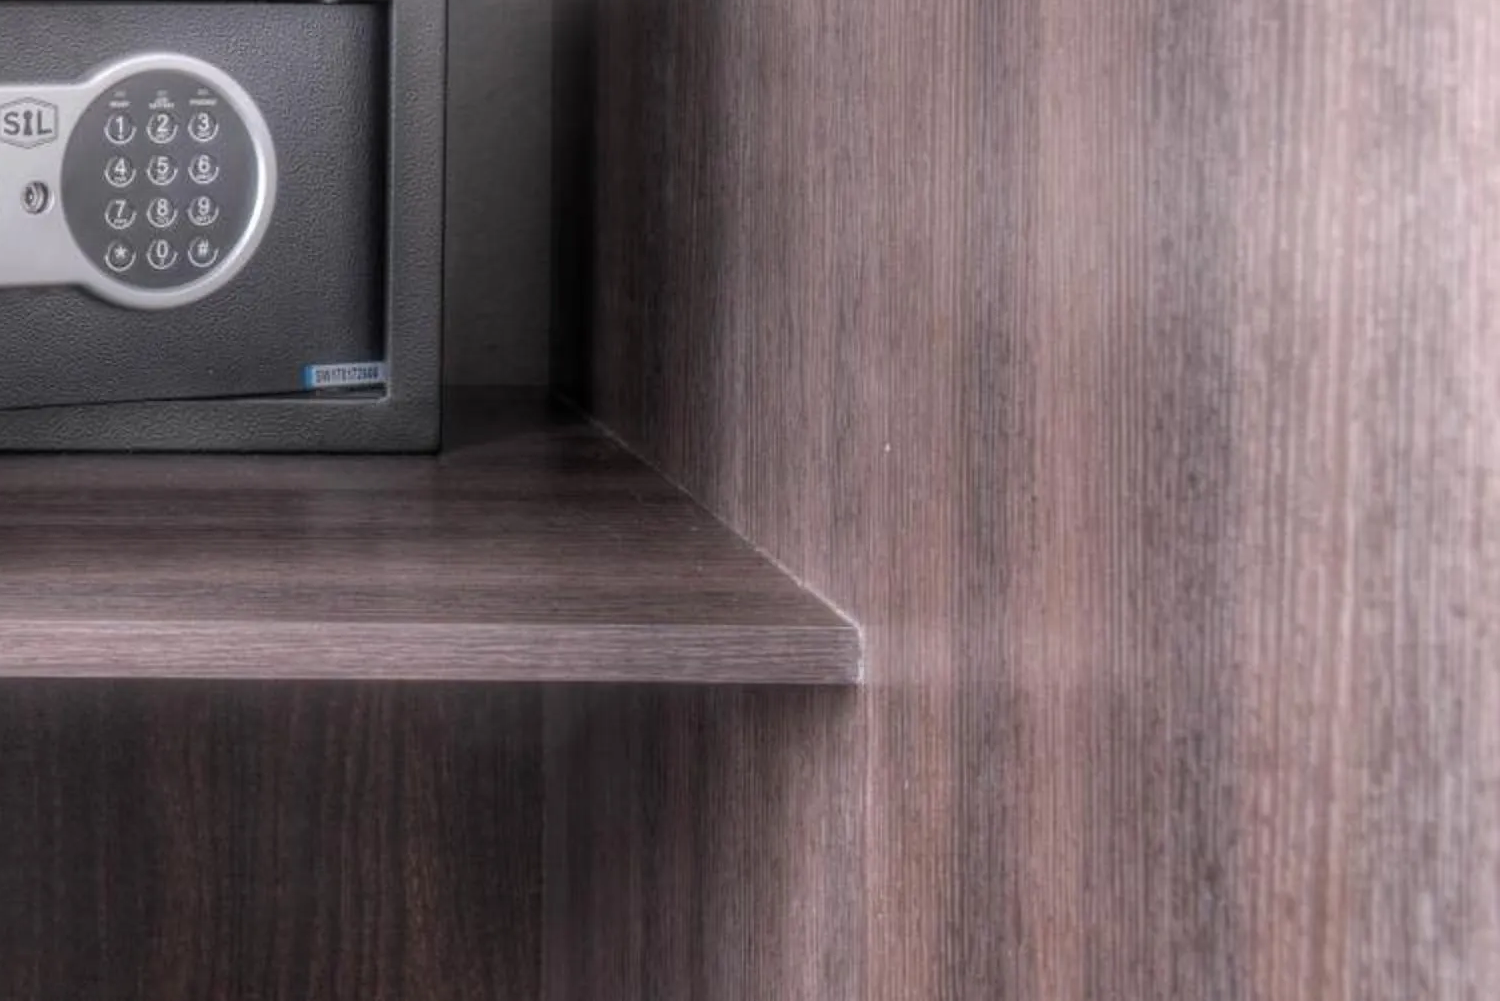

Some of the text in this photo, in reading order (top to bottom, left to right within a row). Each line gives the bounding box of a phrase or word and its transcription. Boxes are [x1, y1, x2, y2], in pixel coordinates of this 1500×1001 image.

[3, 110, 52, 136] SIL
[116, 112, 209, 134] 1 2 3
[115, 154, 210, 175] 4 5 6
[115, 196, 210, 217] 7 8 9
[156, 239, 168, 258] 0
